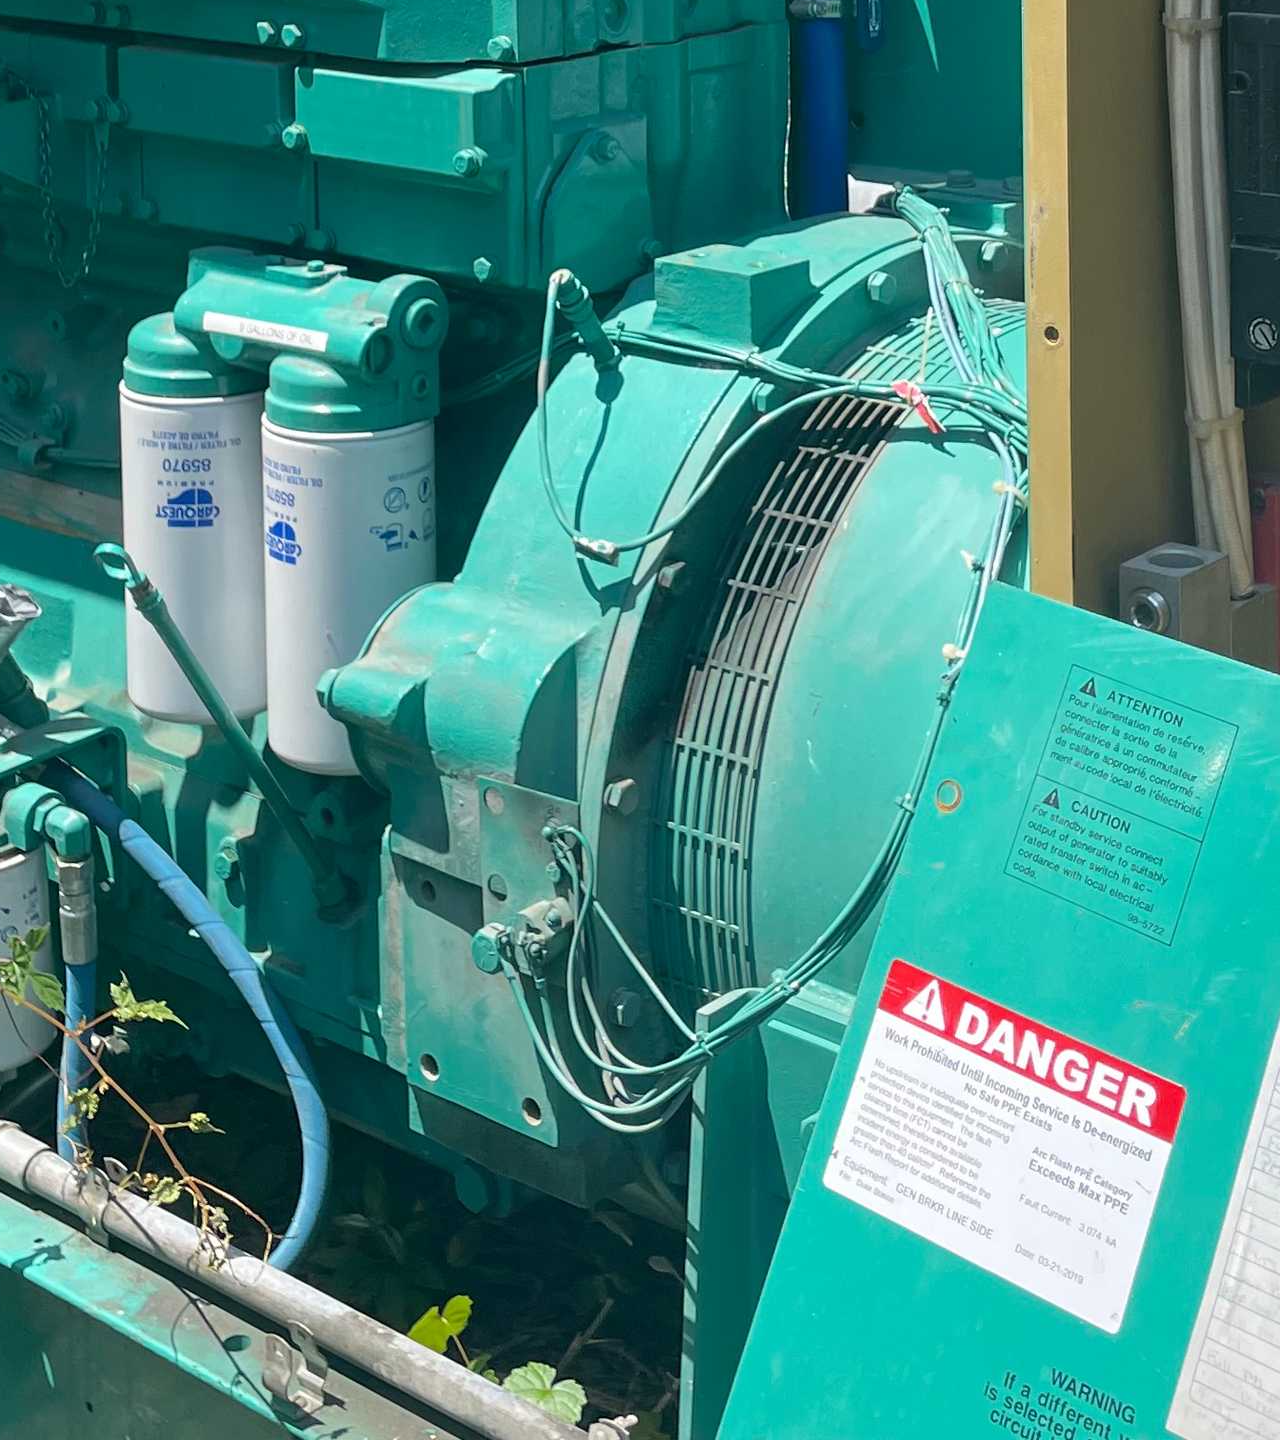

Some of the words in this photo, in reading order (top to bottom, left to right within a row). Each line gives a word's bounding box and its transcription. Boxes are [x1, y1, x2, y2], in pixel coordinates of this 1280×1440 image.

[162, 459, 212, 472] 85970
[156, 504, 220, 518] CARQUEST
[1106, 688, 1184, 728] ATTENTION
[1121, 747, 1134, 758] un
[1122, 730, 1150, 748] sortie
[1153, 742, 1167, 754] de
[1031, 804, 1048, 818] For
[1048, 811, 1086, 835] standby
[1087, 828, 1122, 849] service
[1124, 843, 1163, 867] connect
[1069, 798, 1131, 835] CAUTION
[1016, 846, 1061, 872] cordance
[1061, 865, 1083, 882] with
[1083, 875, 1108, 893] local
[1109, 886, 1154, 913] electrical
[1022, 832, 1048, 850] rated
[1049, 843, 1086, 867] transfer
[1087, 860, 1119, 881] switch
[1026, 818, 1056, 839] output
[1069, 837, 1115, 865] generator
[1128, 861, 1168, 888] suitably
[951, 999, 1164, 1129] DANGER
[883, 1026, 910, 1050] Work
[909, 1039, 960, 1073] Prohibited
[959, 1063, 984, 1084] Until
[982, 1074, 1031, 1108] Incoming
[1031, 1097, 1070, 1125] Service
[1069, 1115, 1082, 1130] Is
[1081, 1120, 1153, 1165] De-energized
[963, 1082, 978, 1097] No
[977, 1089, 1001, 1108] Safe
[1000, 1099, 1022, 1118] PPE
[1021, 1109, 1053, 1133] Exists
[1027, 1158, 1076, 1191] Exceeds
[1076, 1181, 1102, 1203] Max
[1102, 1193, 1130, 1216] PPE
[1031, 1145, 1048, 1160] Arc
[1047, 1153, 1073, 1173] Flash
[1072, 1164, 1092, 1181] PPE
[1091, 1174, 1134, 1203] Category
[894, 1182, 917, 1202] GEN
[917, 1193, 945, 1216] BRKR
[944, 1207, 969, 1228] LINE
[968, 1218, 994, 1241] SIDE
[984, 1381, 998, 1400] is
[1004, 1372, 1017, 1389] If
[1020, 1384, 1031, 1399] a
[1038, 1392, 1111, 1440] different
[1051, 1368, 1136, 1424] WARNING
[990, 1409, 1042, 1440] circuit
